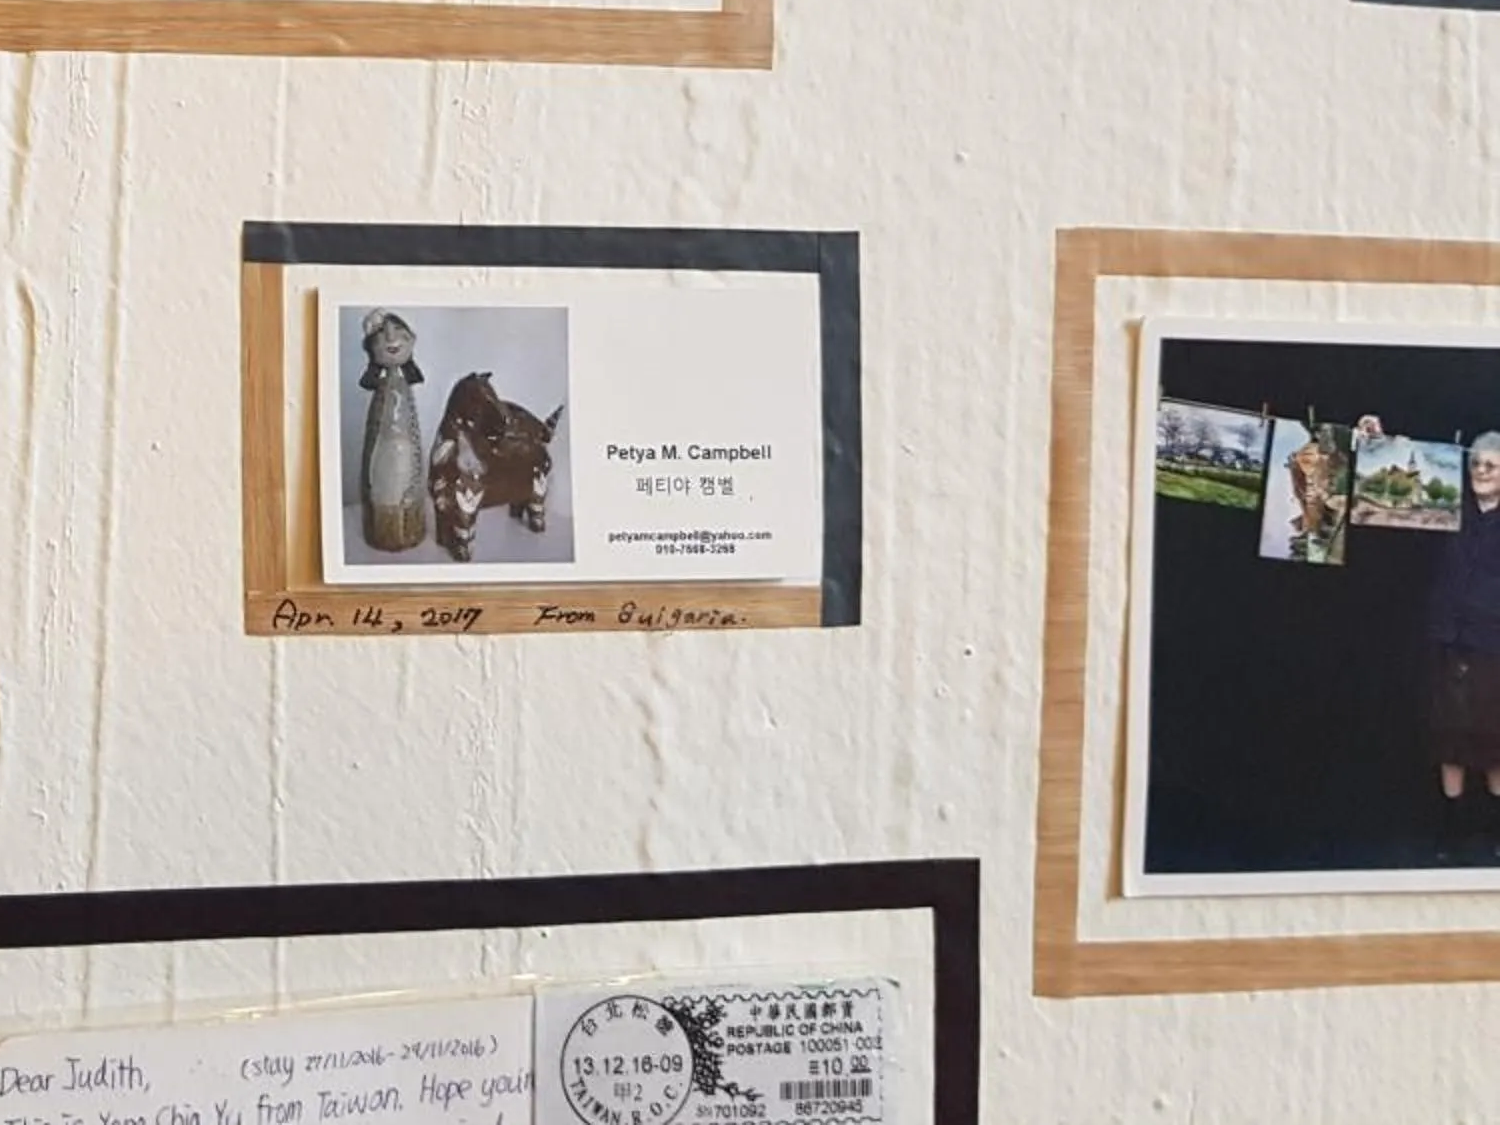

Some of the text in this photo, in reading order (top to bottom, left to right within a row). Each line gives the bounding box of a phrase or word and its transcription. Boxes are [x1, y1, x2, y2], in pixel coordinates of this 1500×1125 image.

[606, 444, 772, 464] Petya M. Campbell
[635, 476, 693, 496] 페티야
[533, 604, 596, 626] From
[727, 1021, 864, 1039] REPUBLIC OF CHINA
[727, 1041, 792, 1056] POSTAGE
[61, 1054, 151, 1094] Judith,
[257, 1092, 304, 1125] from
[419, 1073, 474, 1112] Hope
